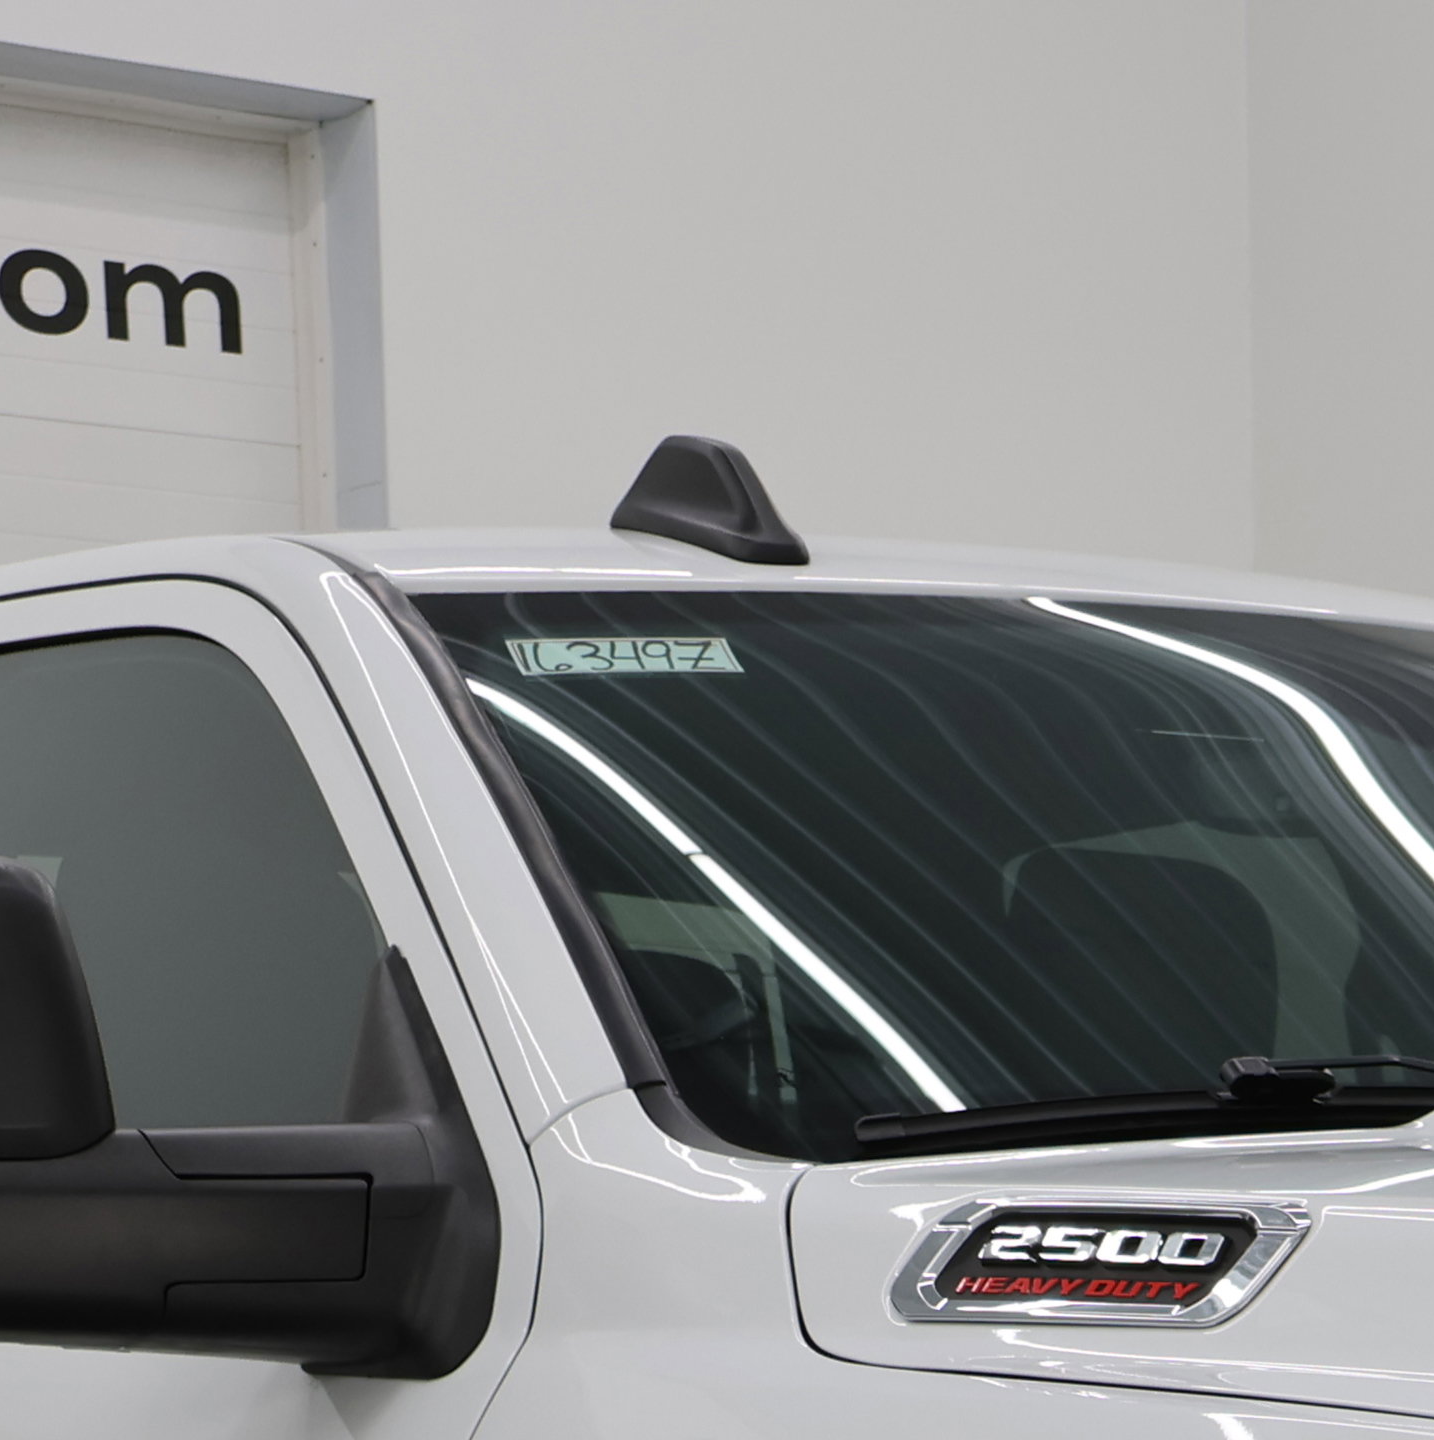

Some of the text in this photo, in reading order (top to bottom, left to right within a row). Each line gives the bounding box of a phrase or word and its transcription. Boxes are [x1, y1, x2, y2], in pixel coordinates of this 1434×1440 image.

[978, 1224, 1227, 1268] 2500
[954, 1275, 1201, 1300] HEAVY DUTY
